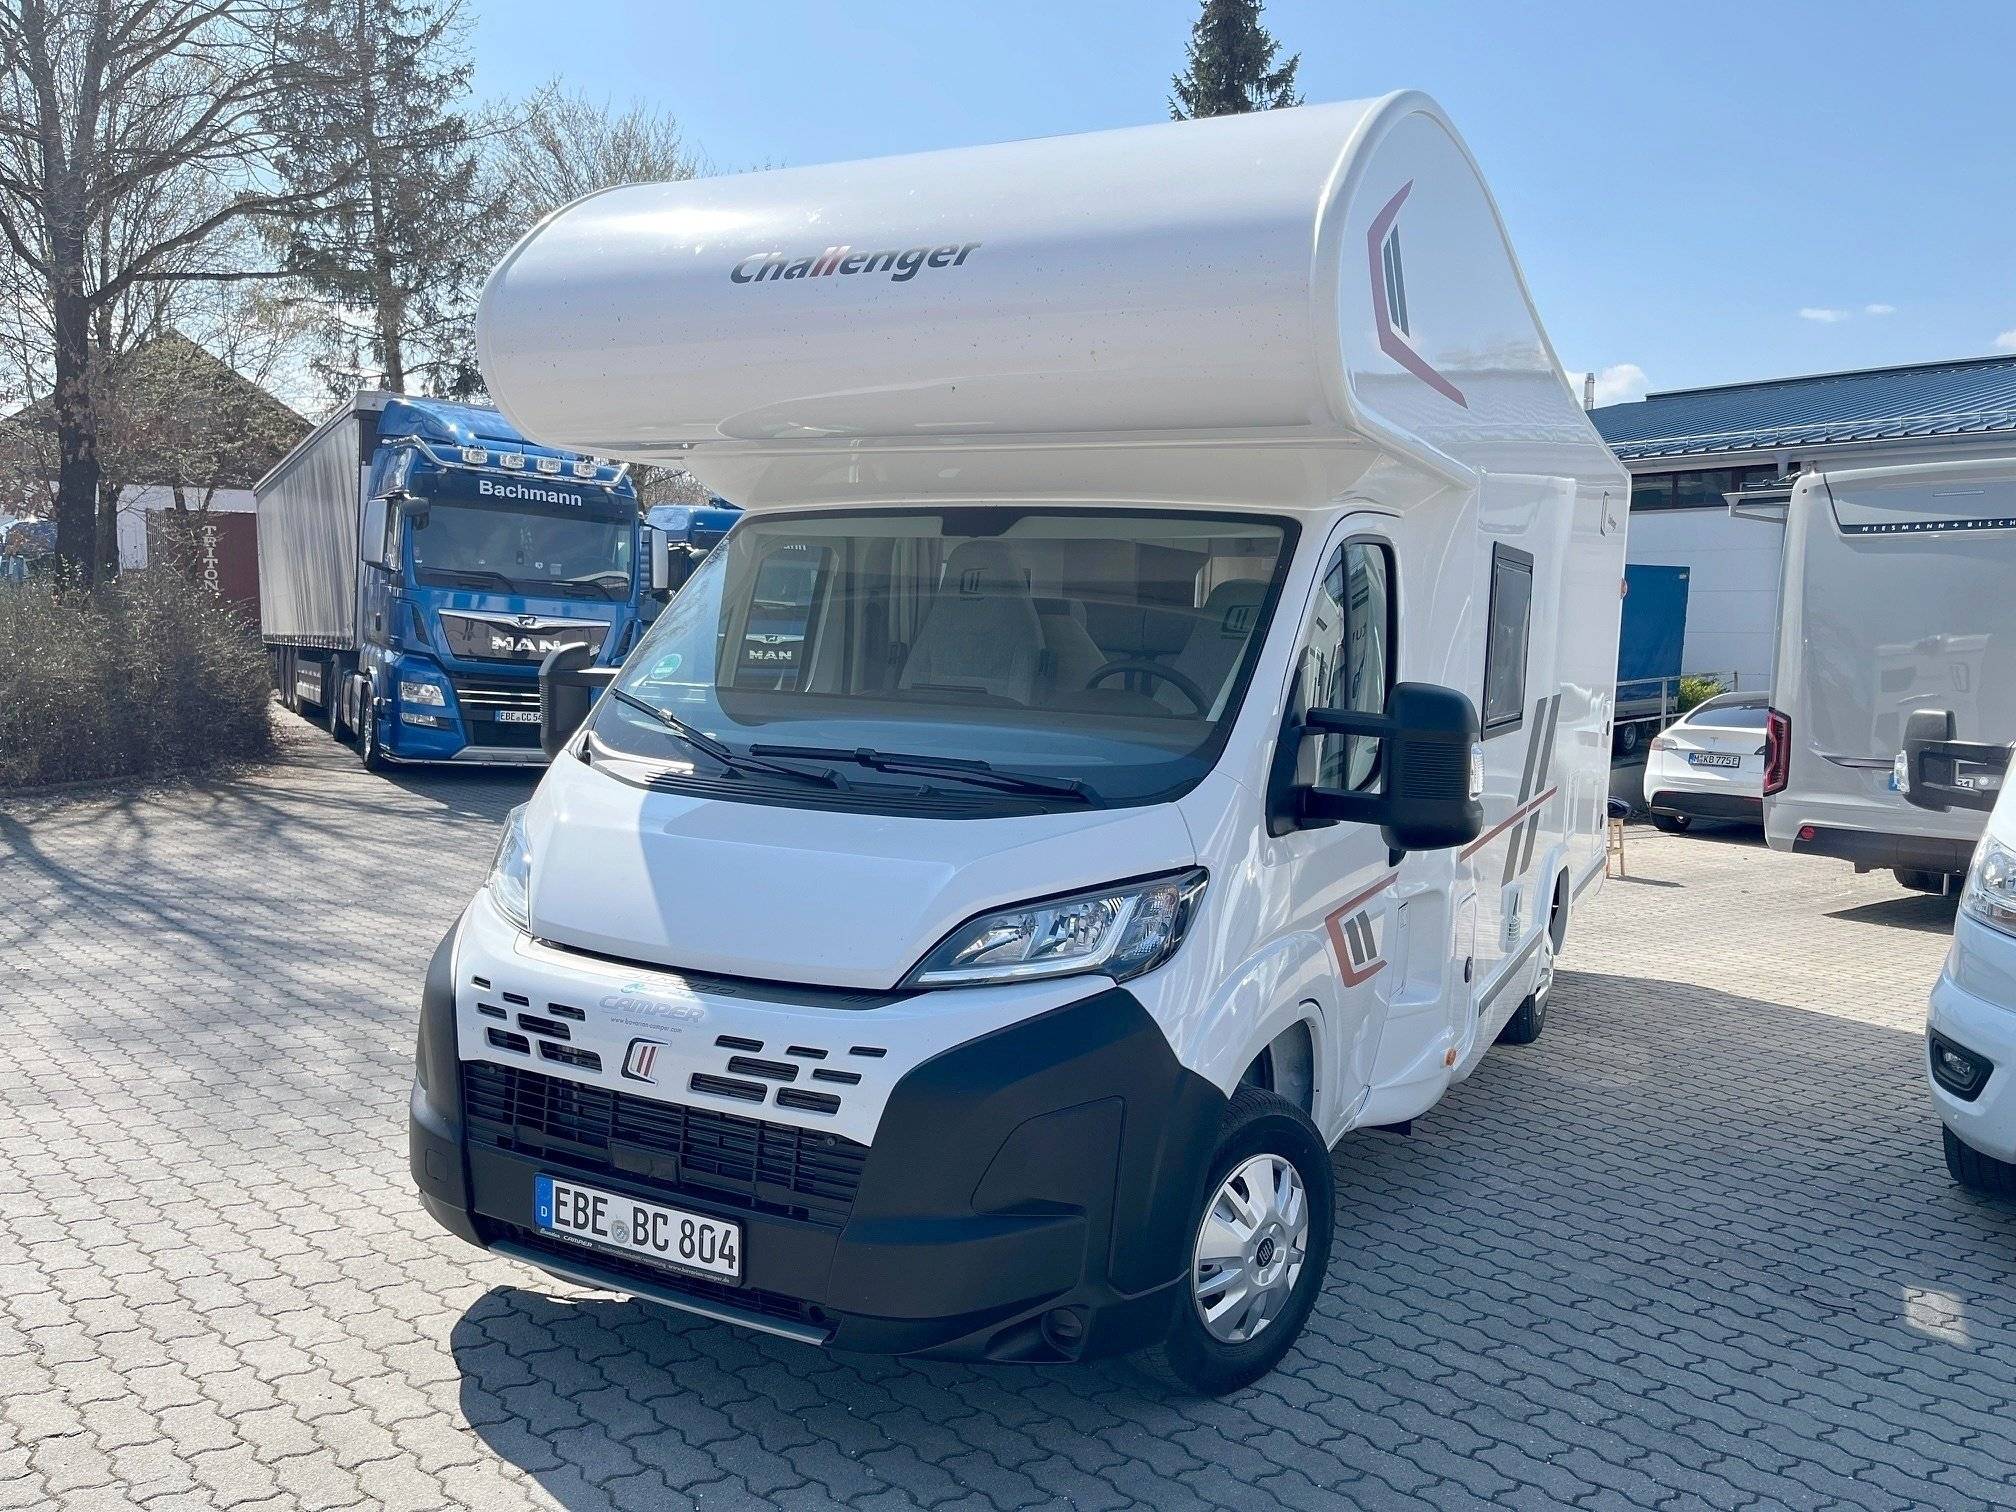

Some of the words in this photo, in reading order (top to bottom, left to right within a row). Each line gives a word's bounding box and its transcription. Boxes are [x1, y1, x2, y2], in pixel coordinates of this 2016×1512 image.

[730, 242, 982, 283] Challenger
[479, 480, 582, 507] Bachmann
[1862, 523, 1945, 531] NIESMANN
[201, 525, 219, 591] TRITON
[491, 636, 561, 652] MAN
[749, 650, 792, 660] MAN
[500, 711, 516, 721] EBE
[600, 995, 705, 1023] CAMPER
[555, 1186, 608, 1237] EBE
[632, 1206, 669, 1252] BC
[678, 1219, 736, 1270] 804
